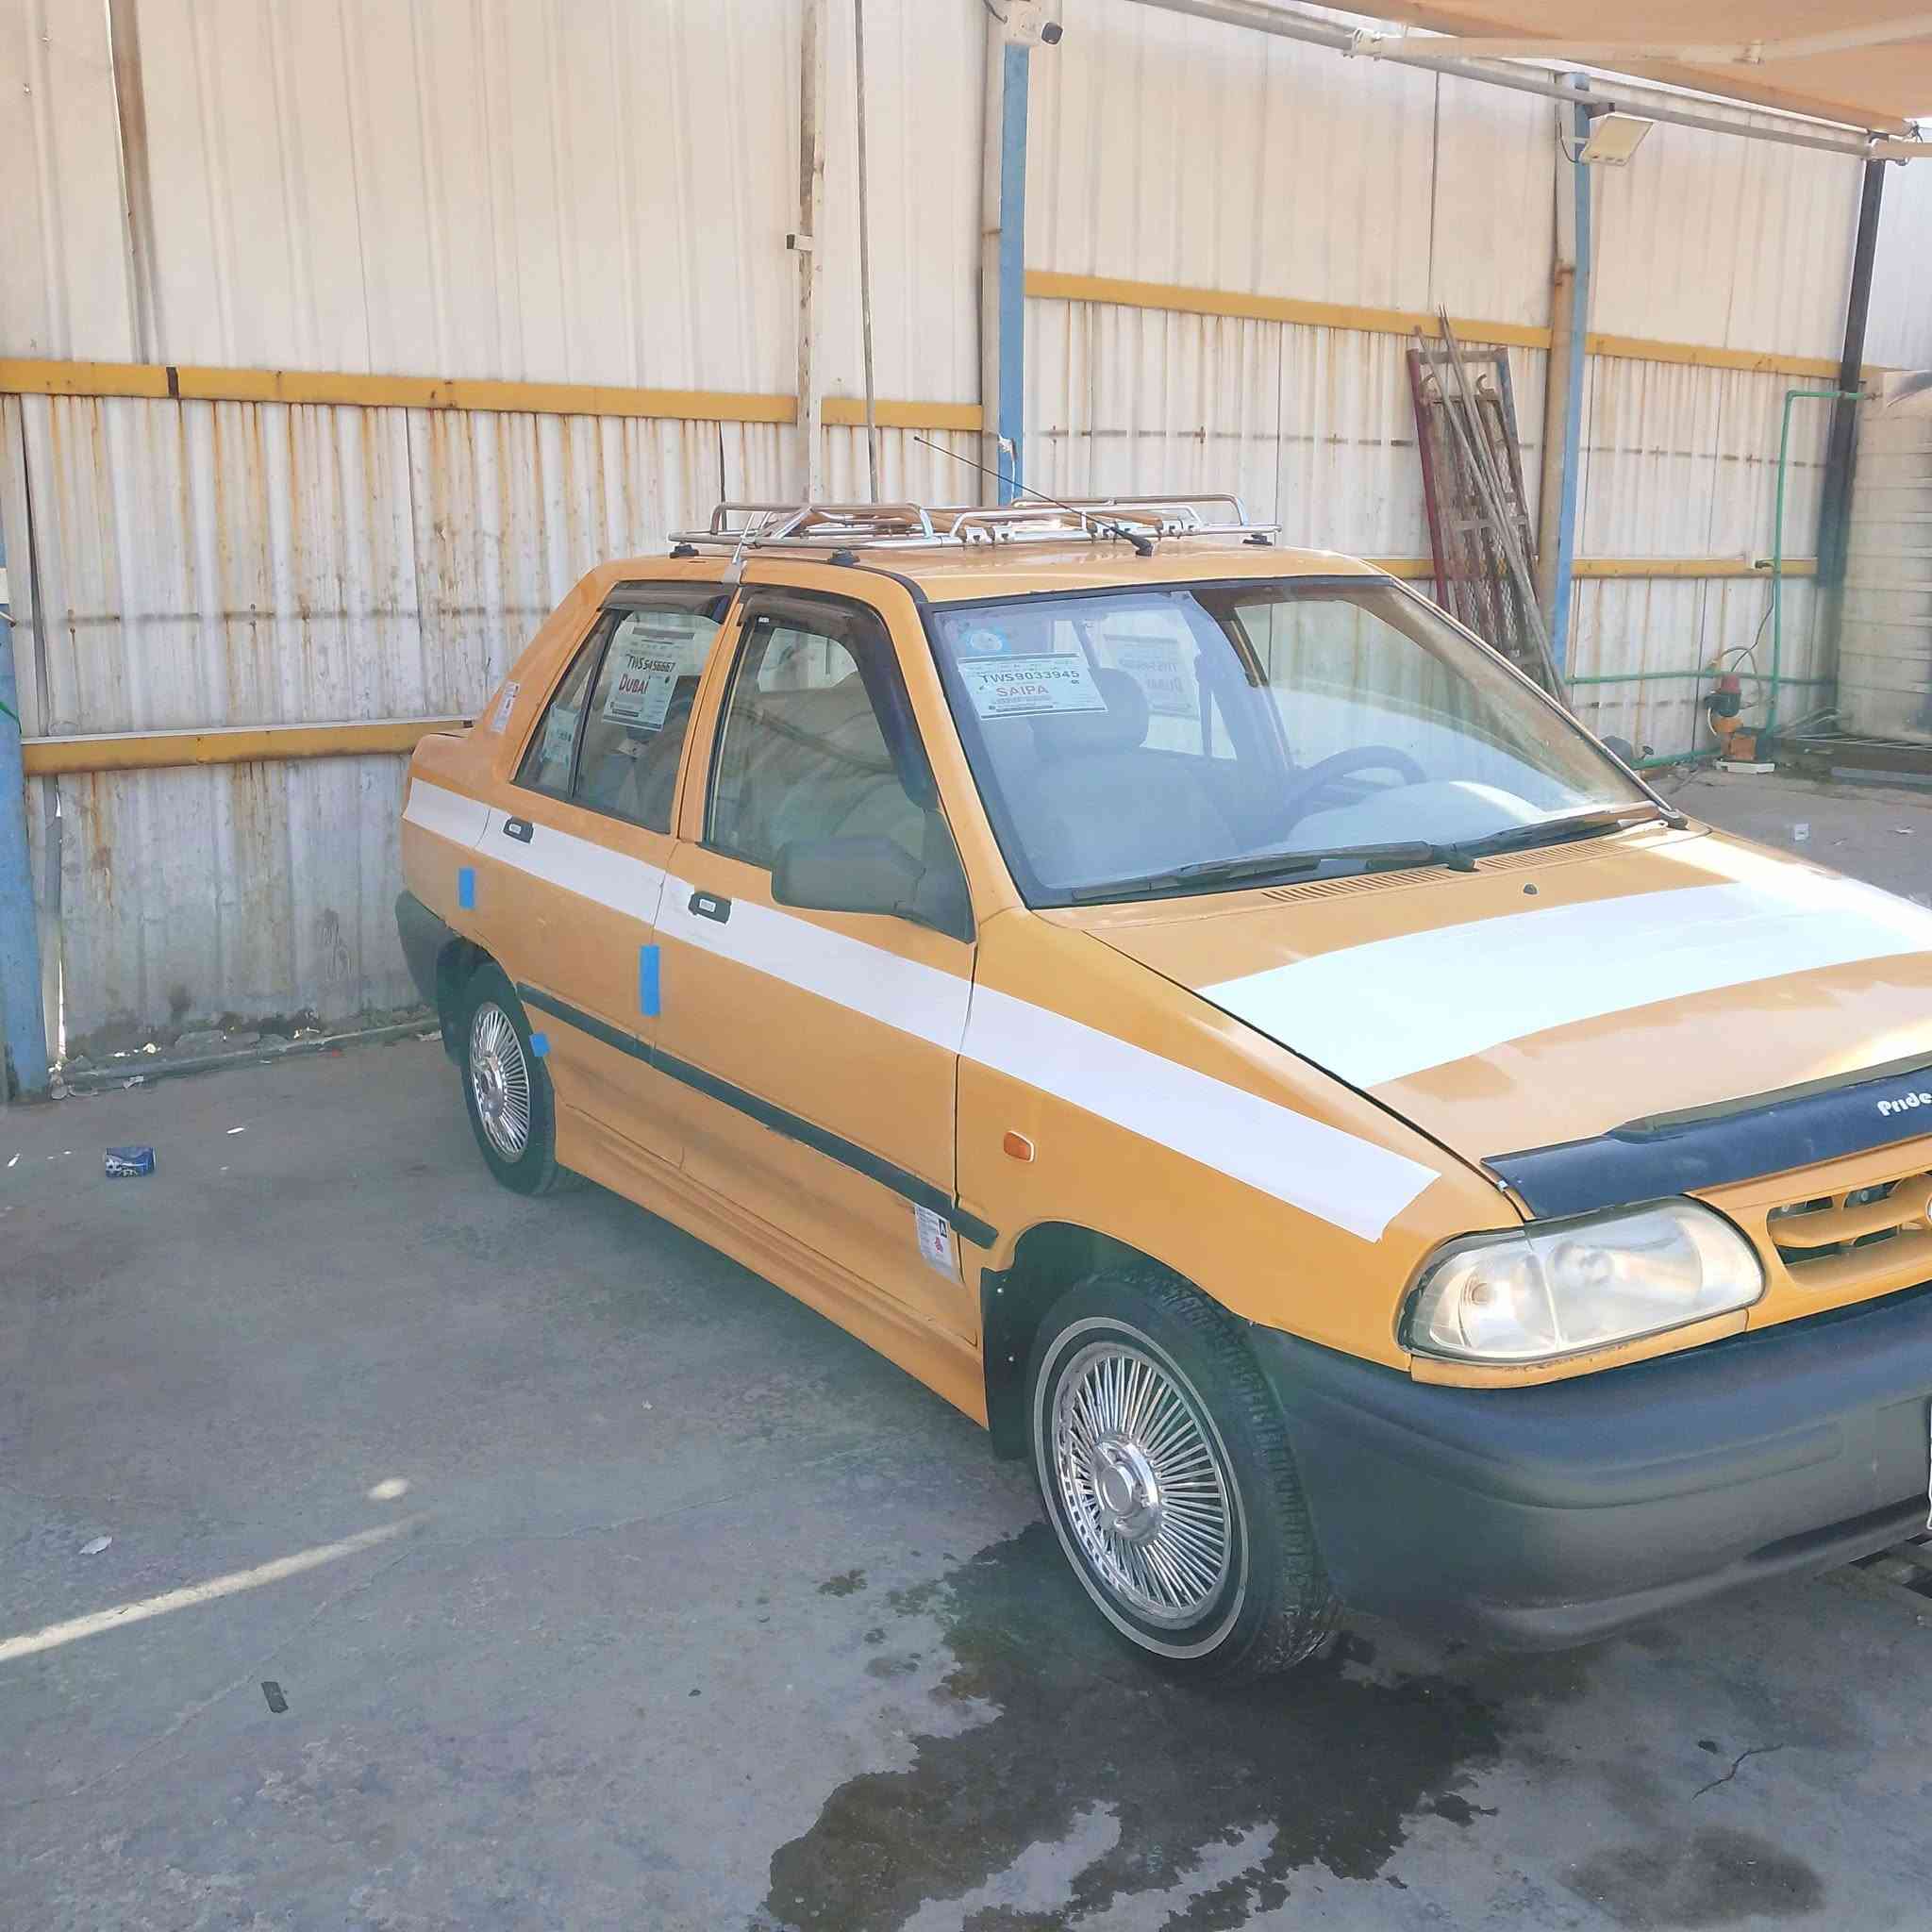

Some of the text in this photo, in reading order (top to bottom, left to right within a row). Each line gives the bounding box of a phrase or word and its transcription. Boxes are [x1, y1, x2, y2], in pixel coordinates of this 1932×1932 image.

[982, 670, 1080, 684] TWS9033945
[995, 685, 1049, 697] SAIPA
[1876, 1092, 1932, 1117] Pride
